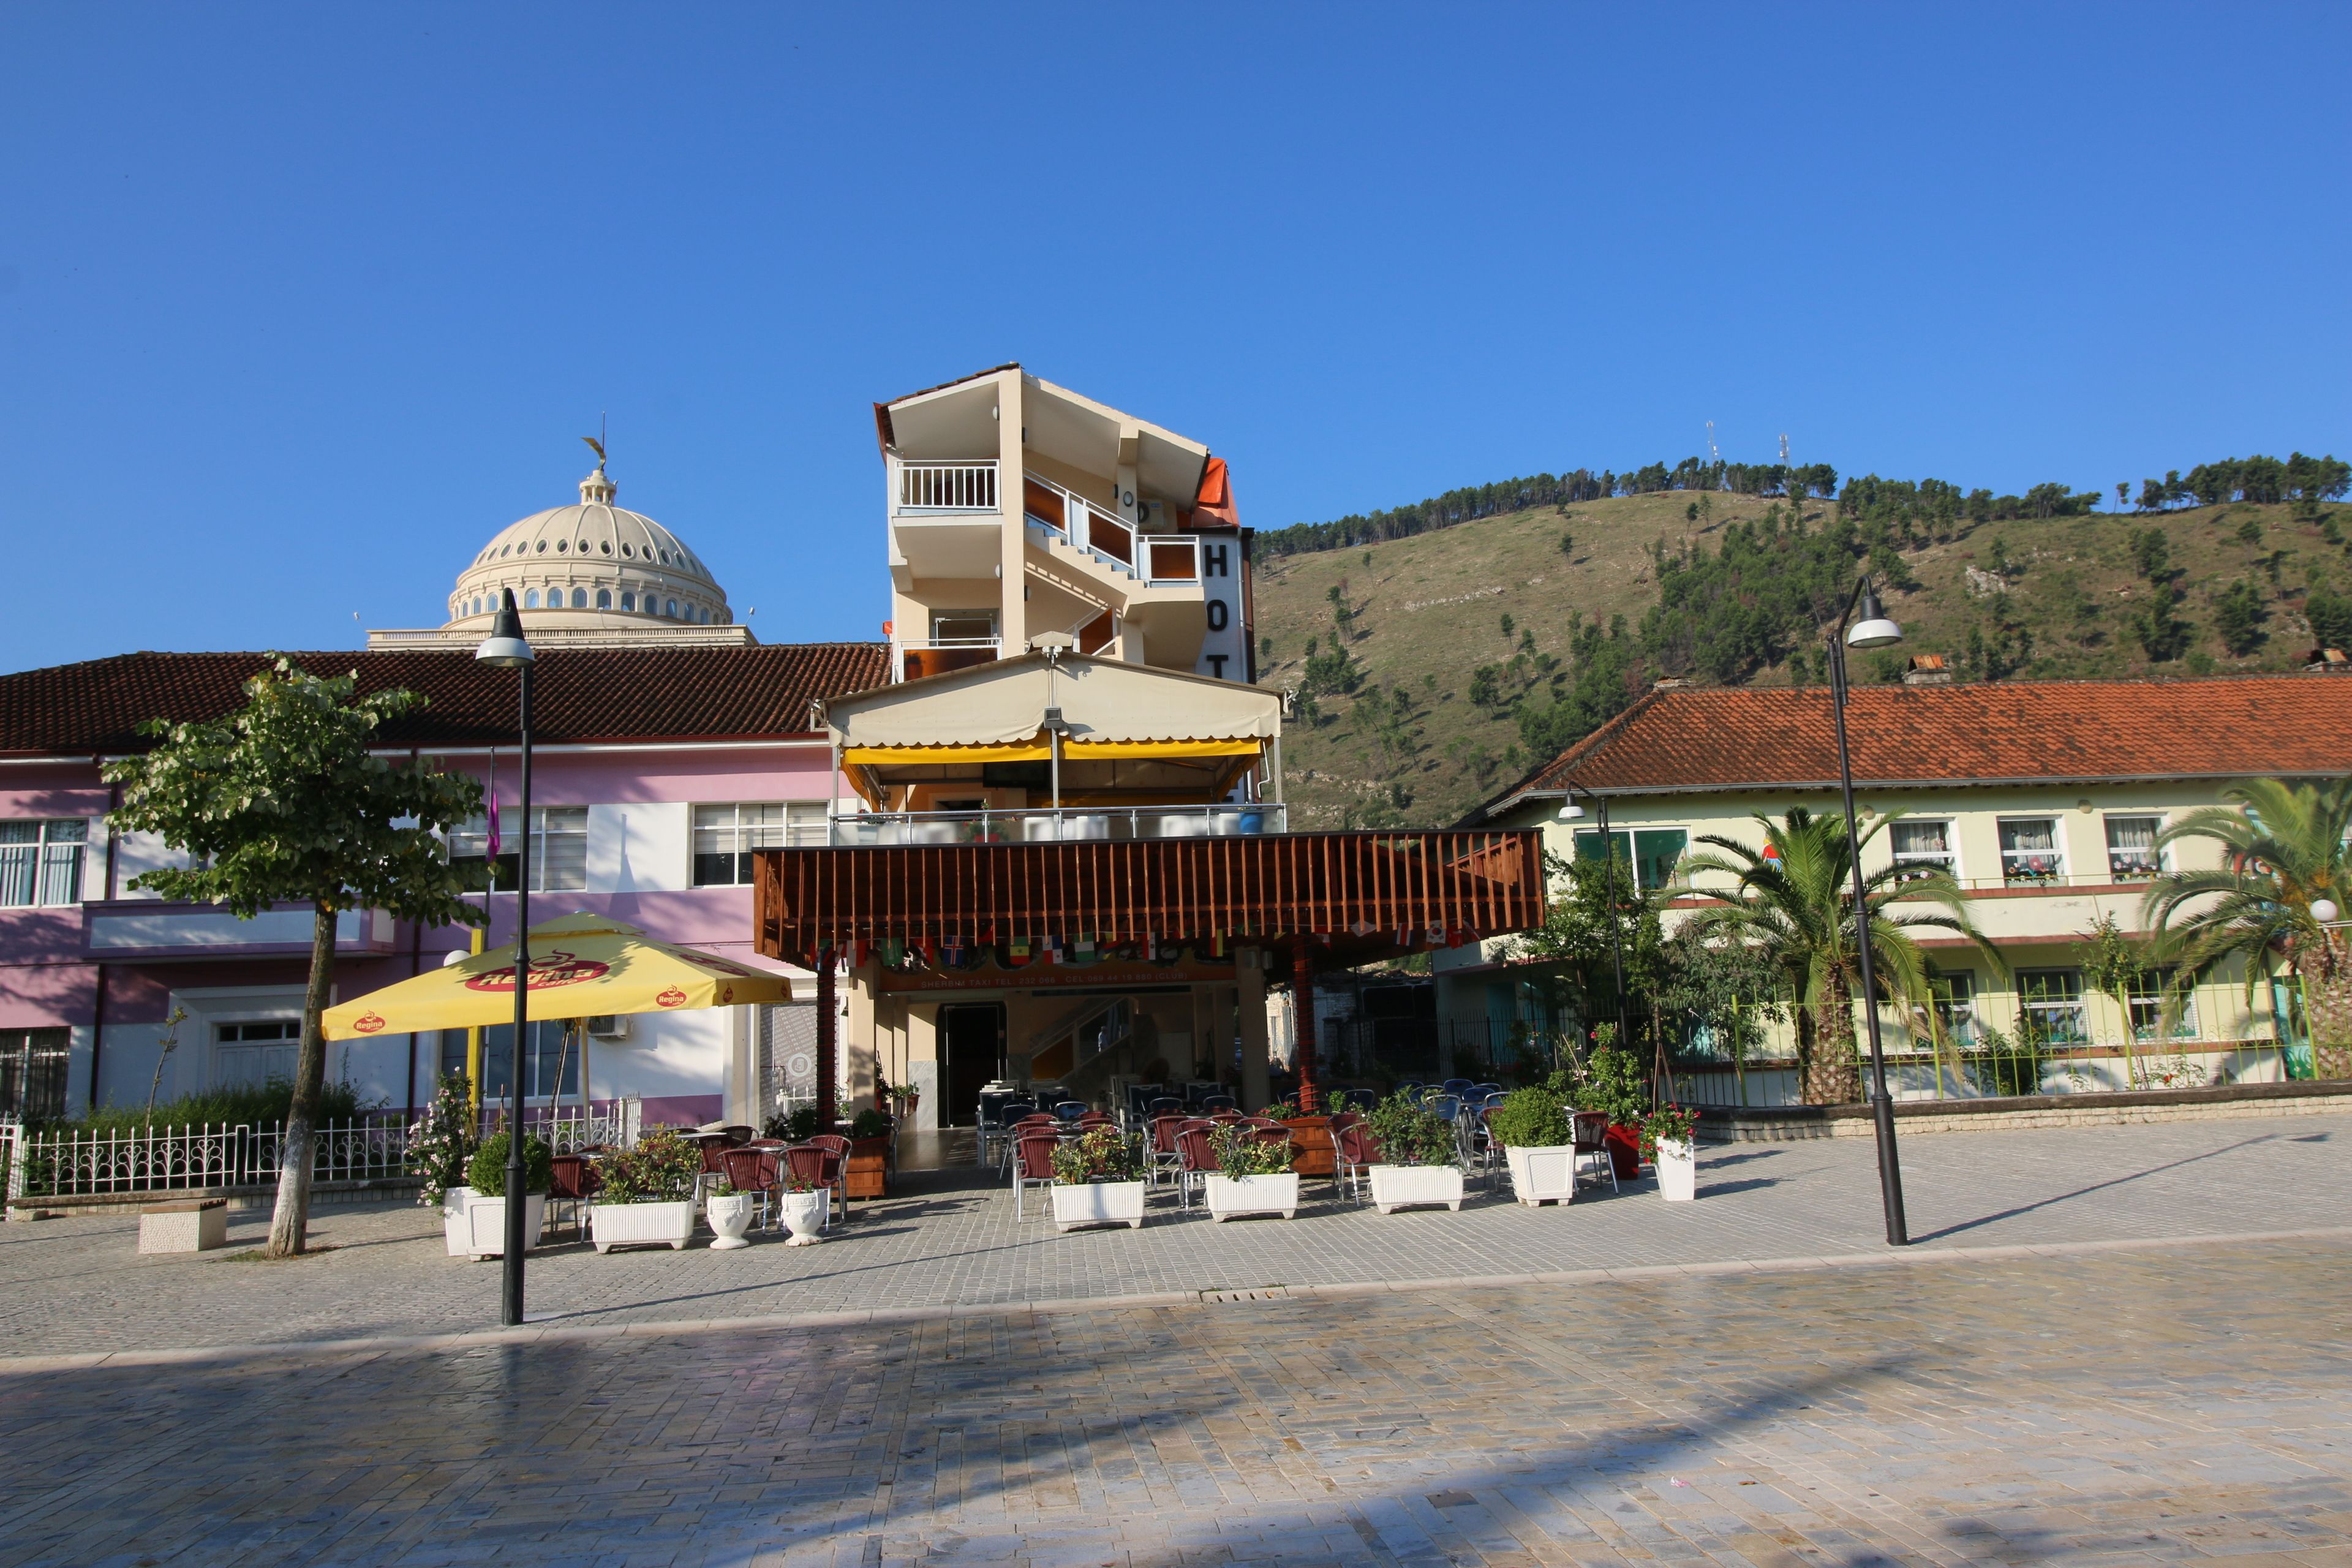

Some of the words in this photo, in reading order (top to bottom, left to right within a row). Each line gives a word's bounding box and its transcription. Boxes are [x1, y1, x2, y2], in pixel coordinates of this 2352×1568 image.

[1155, 972, 1188, 981] (CLUB)
[658, 995, 684, 1004] Regina
[356, 1021, 383, 1030] Regina
